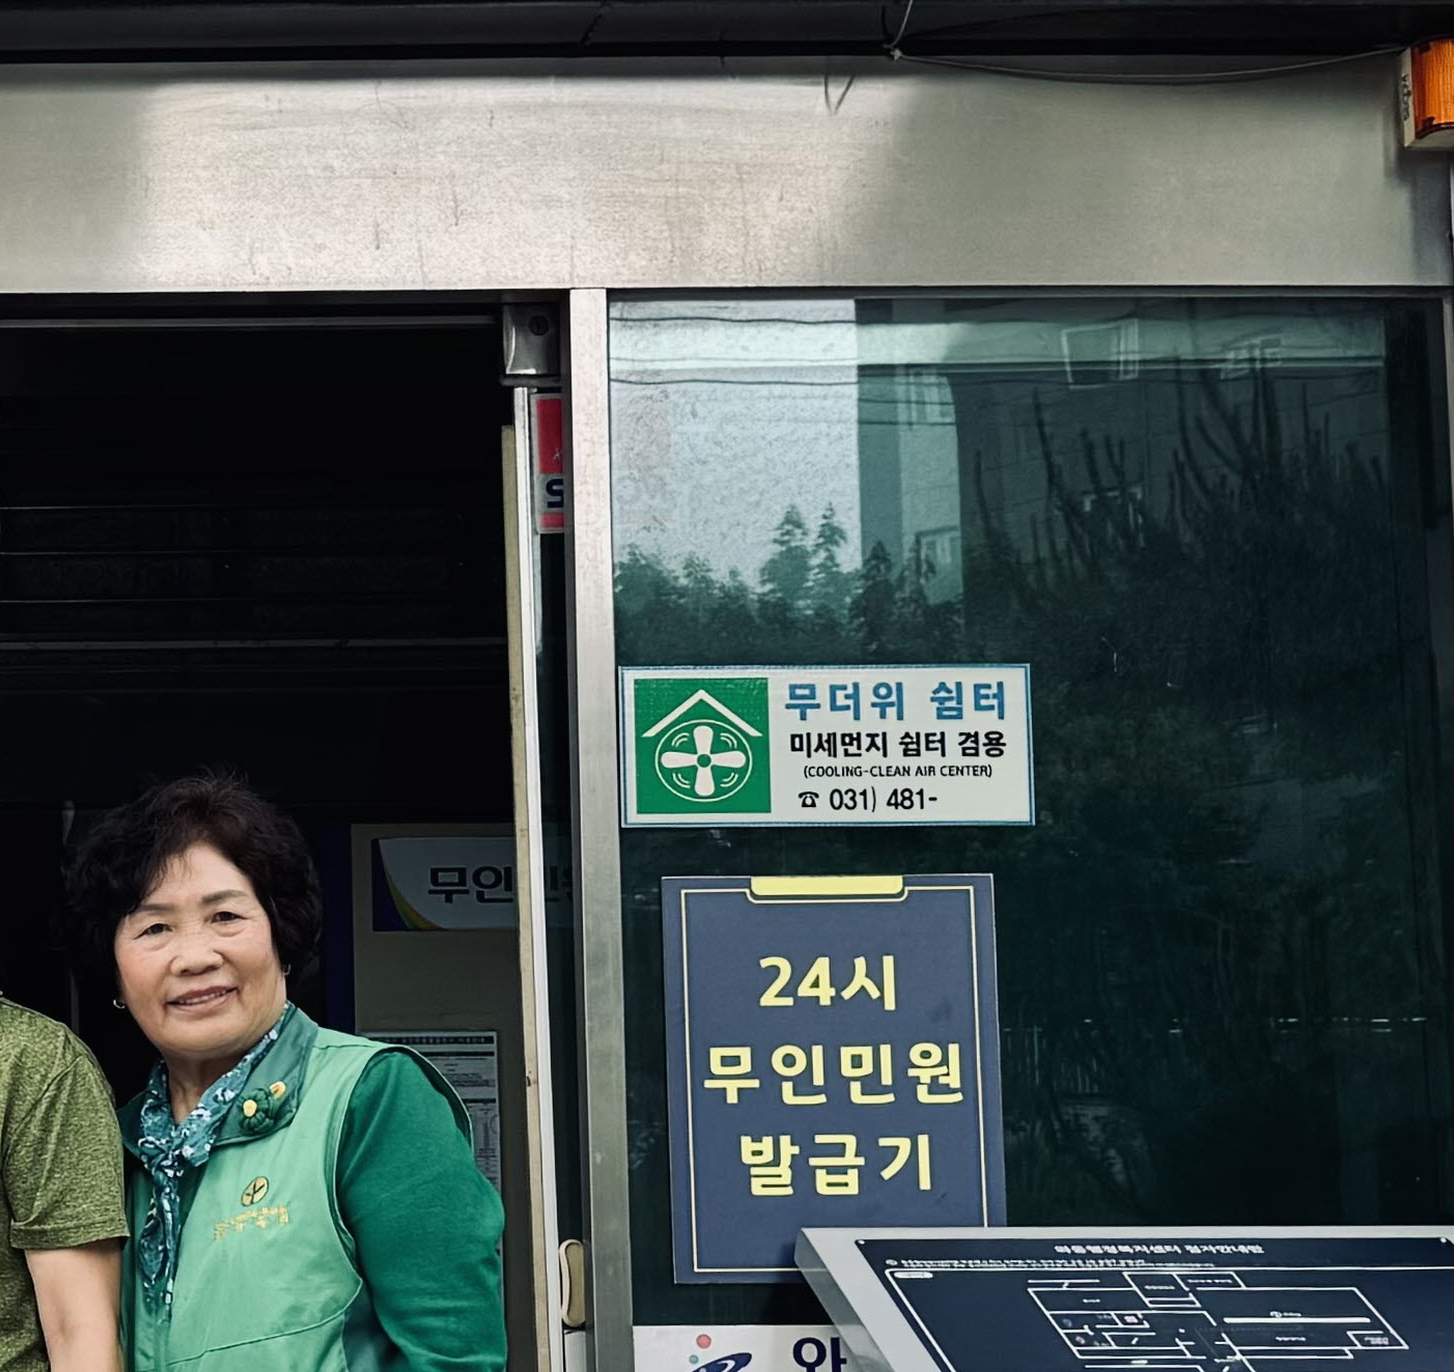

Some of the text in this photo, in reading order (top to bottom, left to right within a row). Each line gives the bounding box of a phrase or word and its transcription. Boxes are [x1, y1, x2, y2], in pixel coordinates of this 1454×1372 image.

[784, 680, 1005, 722] 무더위 쉼터
[790, 730, 1007, 759] 미세먼지 쉼터 겸용
[803, 764, 993, 779] (COOLING-CLEAN AIR CENTER)
[829, 786, 938, 813] 031) 481-
[759, 955, 896, 1011] 24시
[703, 1042, 964, 1105] 무인민원
[740, 1134, 931, 1196] 발급기
